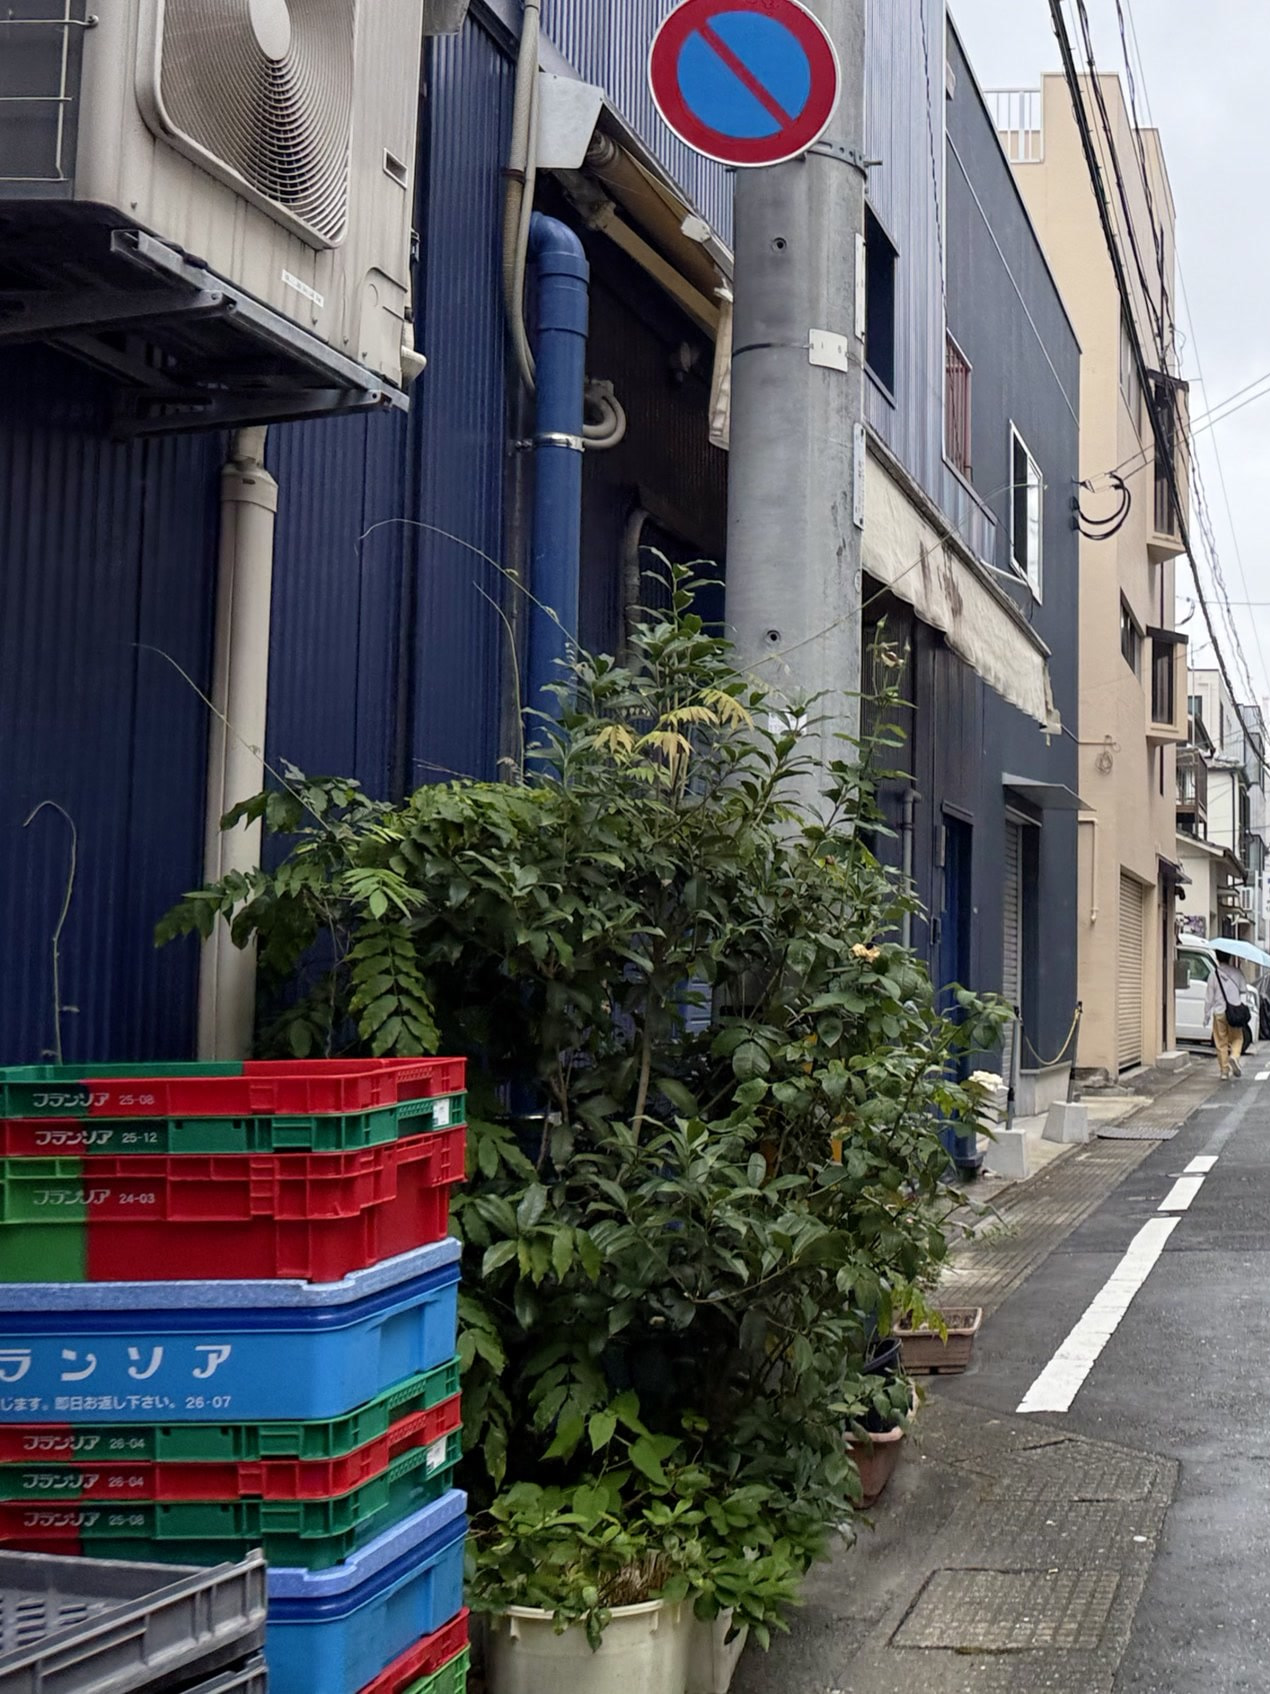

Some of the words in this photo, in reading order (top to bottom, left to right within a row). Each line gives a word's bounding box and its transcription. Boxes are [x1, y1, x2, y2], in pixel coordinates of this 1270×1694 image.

[33, 1093, 109, 1107] フランソア
[35, 1130, 113, 1145] フランソア
[122, 1132, 158, 1143] 25-12
[33, 1189, 111, 1205] フランソア
[119, 1193, 156, 1204] 24-03
[185, 1396, 231, 1409] 26-07
[23, 1435, 100, 1450] フランソア
[22, 1474, 99, 1488] フランソア
[24, 1512, 100, 1527] フランソア
